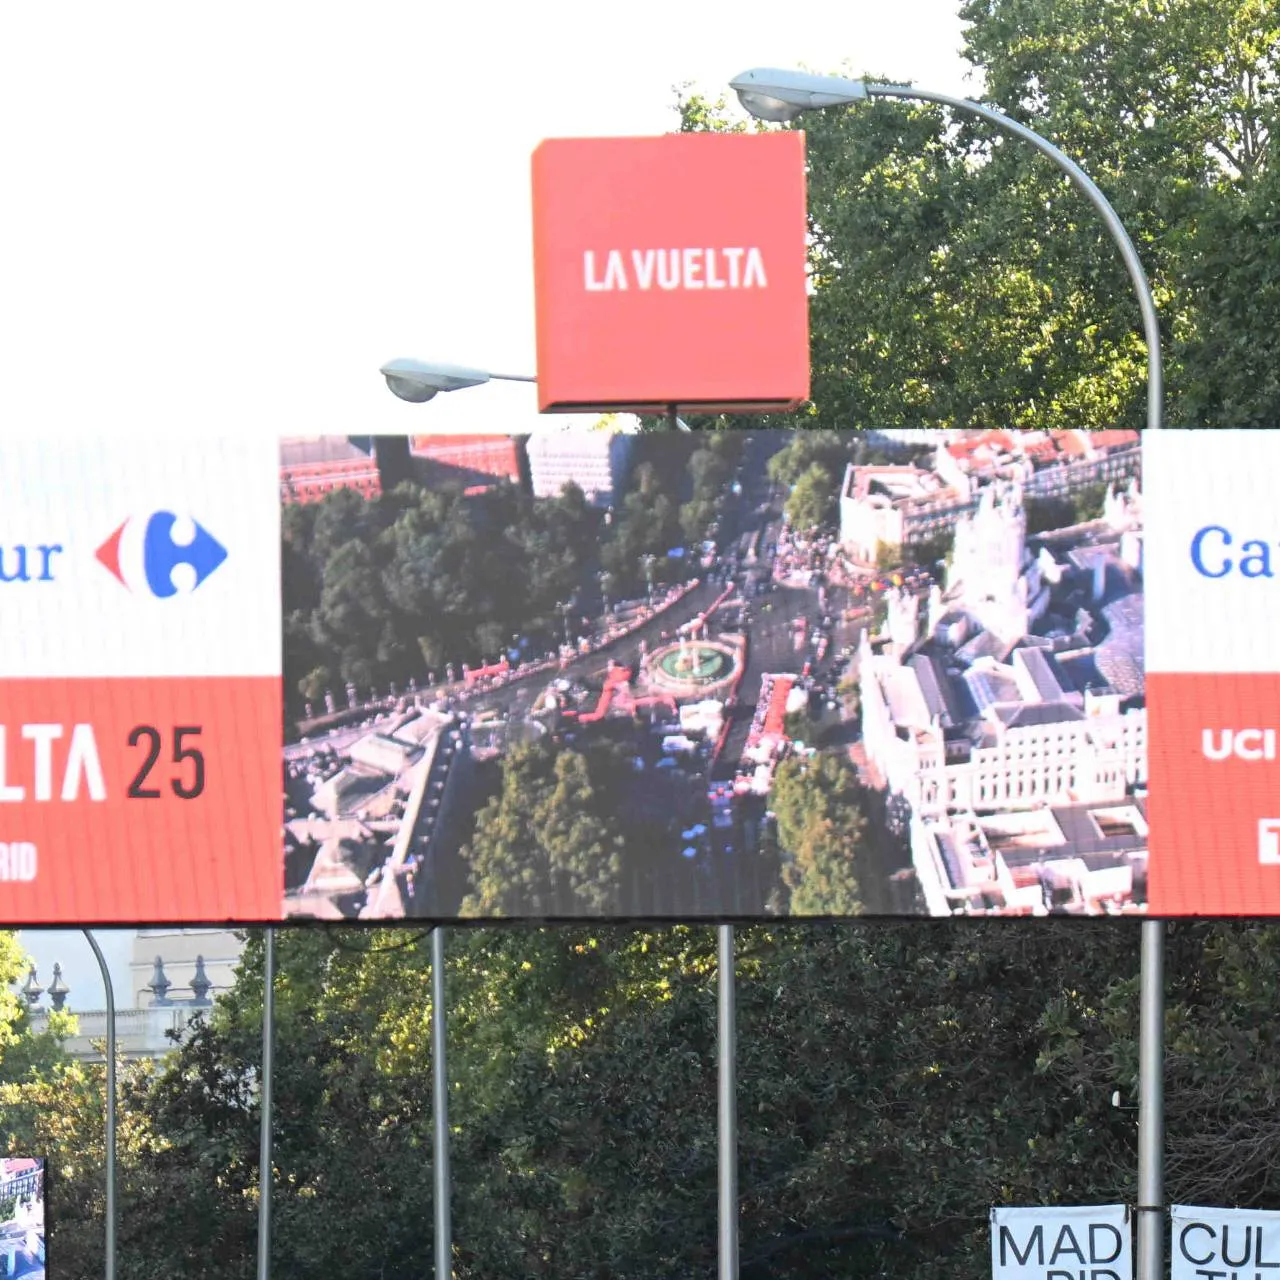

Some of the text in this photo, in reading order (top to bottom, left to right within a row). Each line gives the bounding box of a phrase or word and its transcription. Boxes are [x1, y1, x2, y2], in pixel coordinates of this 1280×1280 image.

[583, 247, 768, 292] LA VUELTA
[126, 724, 206, 801] 25
[1201, 727, 1276, 761] UCI
[999, 1223, 1123, 1267] MAD
[1179, 1222, 1280, 1269] CUL
